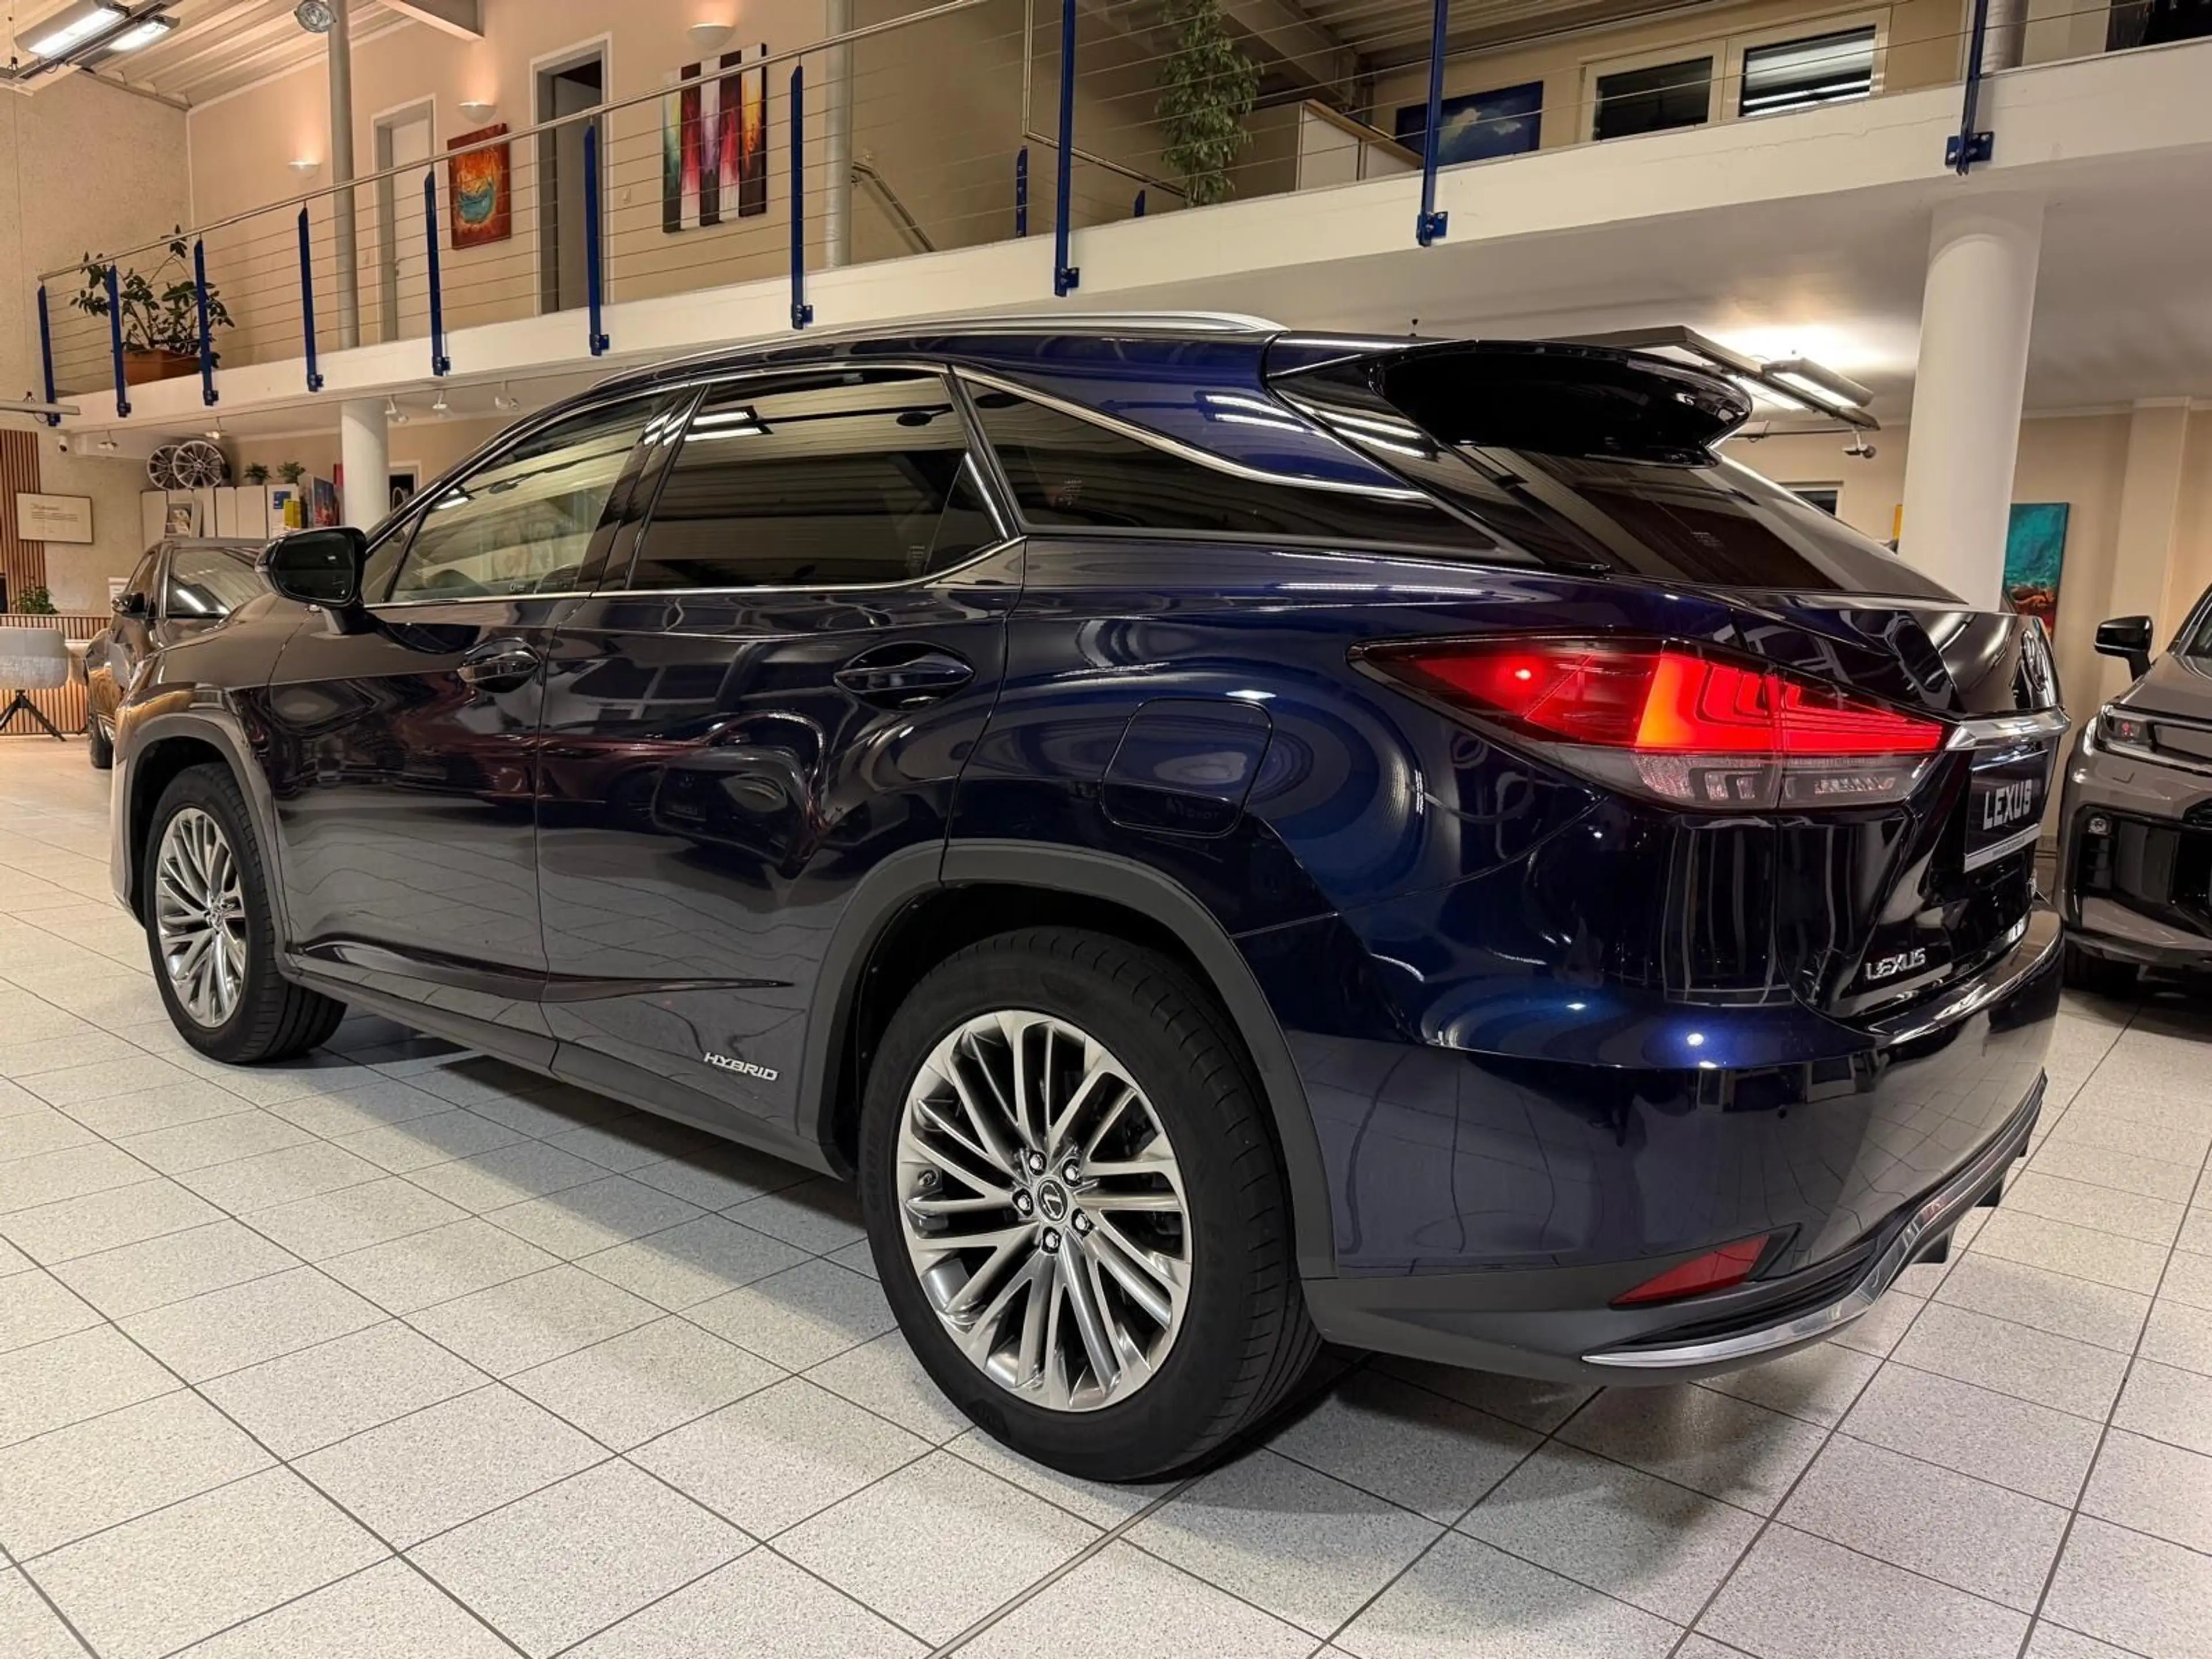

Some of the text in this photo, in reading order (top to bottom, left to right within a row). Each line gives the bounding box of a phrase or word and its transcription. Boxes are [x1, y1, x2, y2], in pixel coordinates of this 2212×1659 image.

[1983, 779, 2032, 831] LEXUS
[1865, 947, 1926, 980] LEXUS
[704, 1051, 779, 1081] HYBRID
